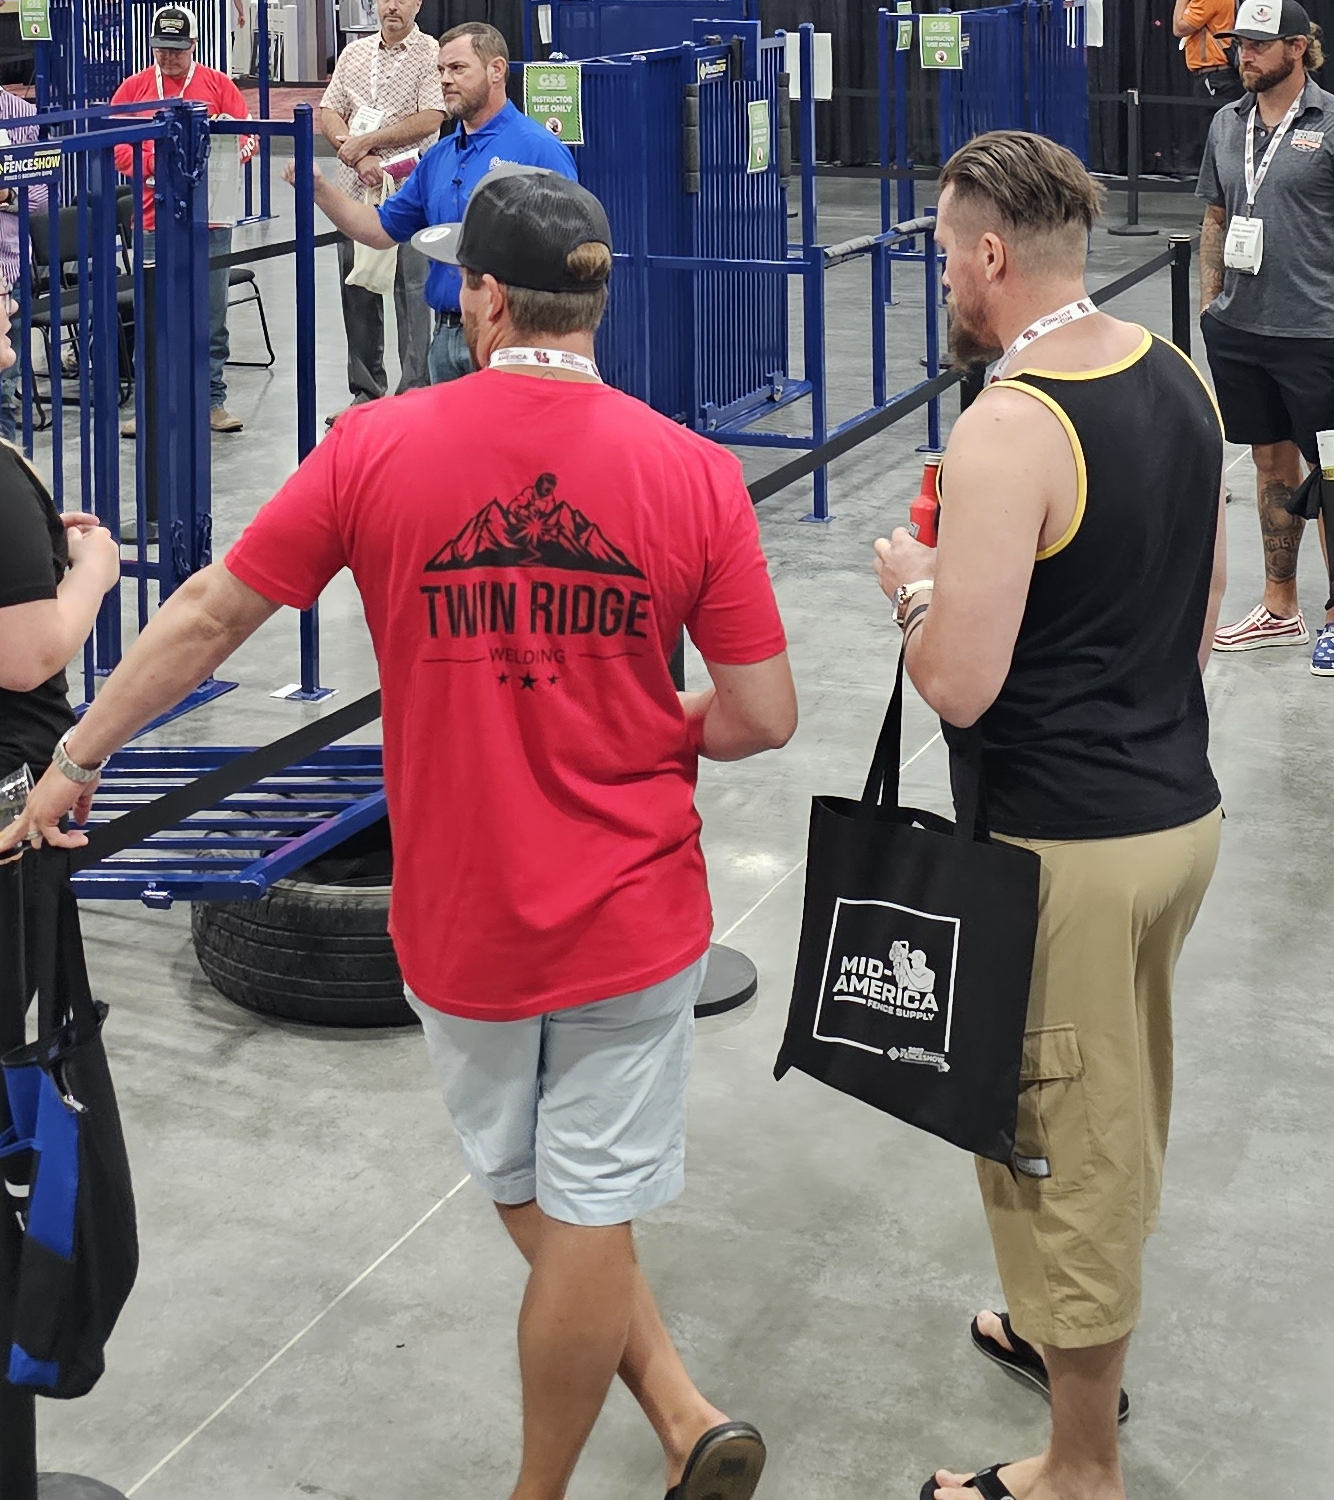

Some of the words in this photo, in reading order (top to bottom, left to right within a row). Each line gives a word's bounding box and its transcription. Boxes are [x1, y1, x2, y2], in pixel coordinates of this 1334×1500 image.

[930, 21, 951, 30] GSS
[538, 73, 567, 87] GSS
[531, 95, 573, 104] INSTRUCTOR
[533, 104, 550, 113] USE
[550, 104, 573, 113] ONLY
[3, 155, 61, 174] FENCESHOW
[419, 580, 516, 639] TWIN
[530, 581, 651, 640] RIDGE
[489, 647, 567, 665] WELDING
[840, 956, 893, 979] MID-
[832, 974, 940, 1012] AMERICA
[867, 998, 895, 1016] FENCE
[895, 1006, 935, 1022] SUPPLY
